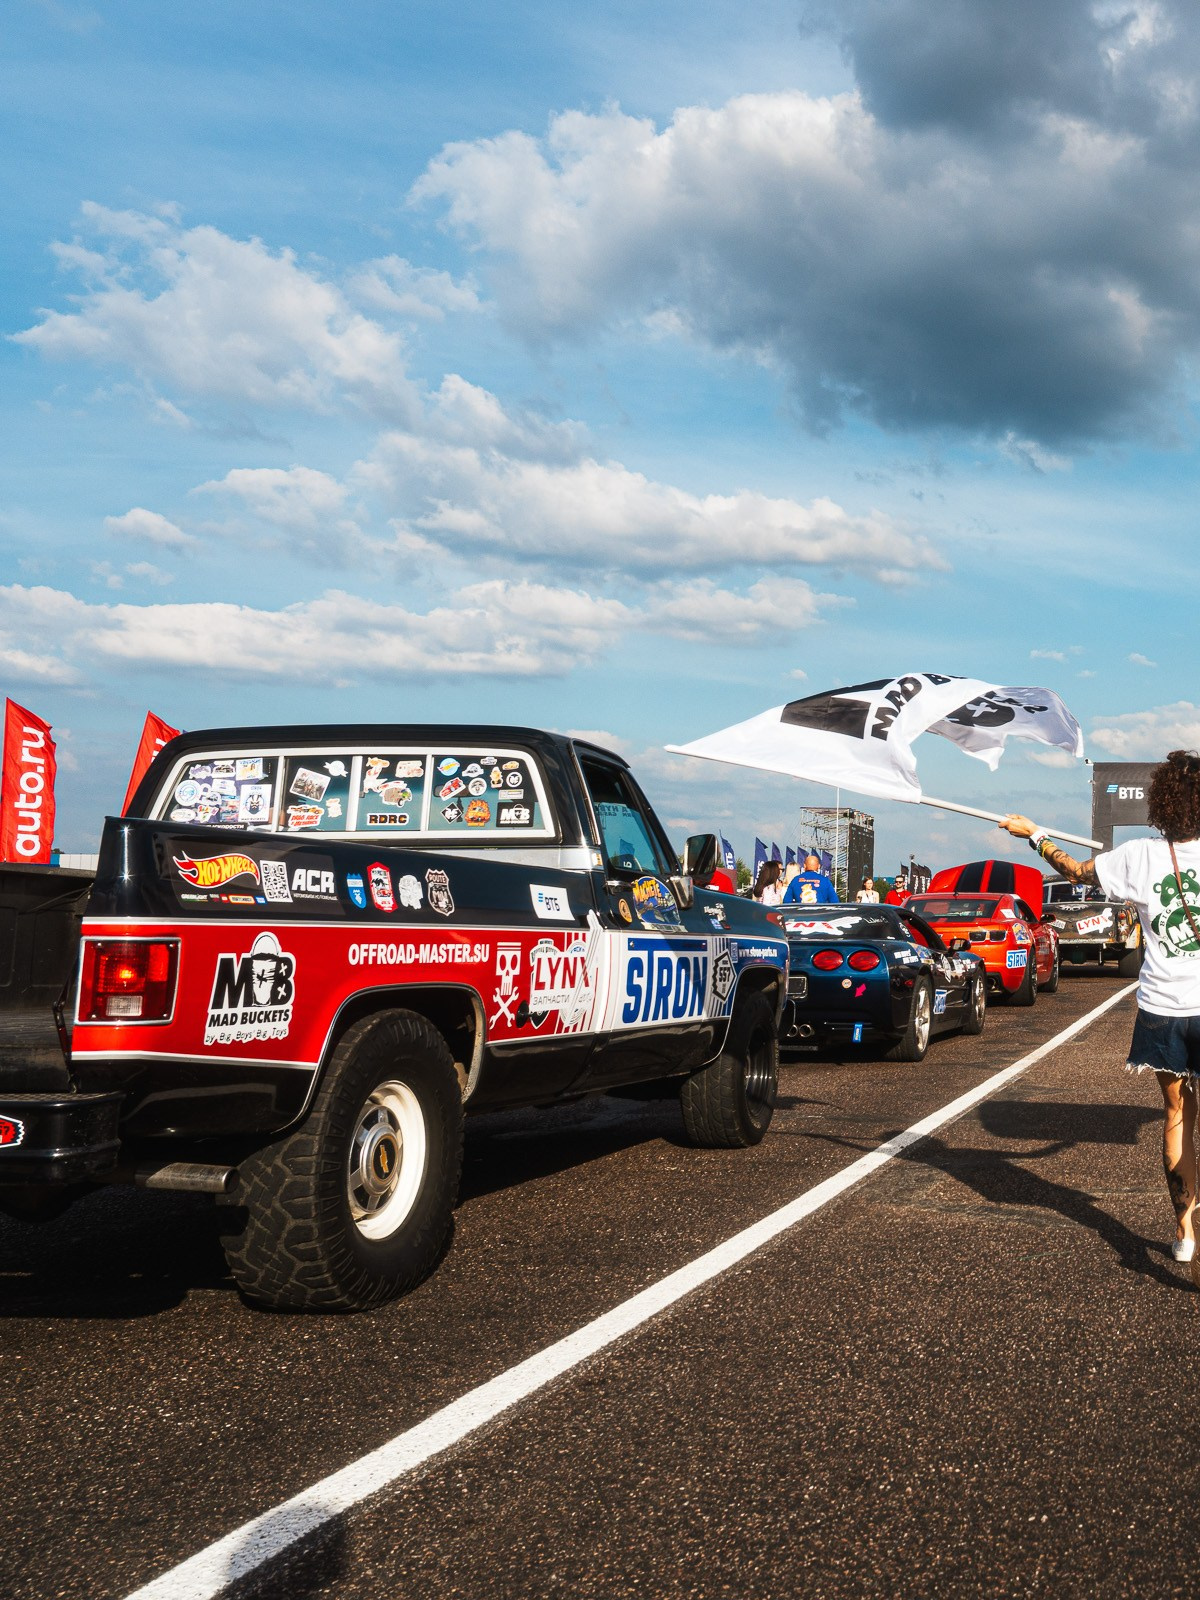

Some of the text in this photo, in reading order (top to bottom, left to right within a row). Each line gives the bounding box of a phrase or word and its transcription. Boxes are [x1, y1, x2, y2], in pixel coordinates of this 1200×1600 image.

[15, 726, 46, 857] auto.ru
[1118, 786, 1145, 800] ВТБ
[369, 814, 408, 824] RDRC
[291, 868, 335, 893] ACR
[544, 896, 561, 912] ВТБ
[1160, 909, 1172, 927] BIG
[348, 943, 490, 966] OFFROAD-MASTER.SU
[1174, 948, 1196, 957] BIG
[533, 994, 570, 1006] ЗАПЧАСТИ
[208, 1008, 290, 1027] MAD BUCKETS
